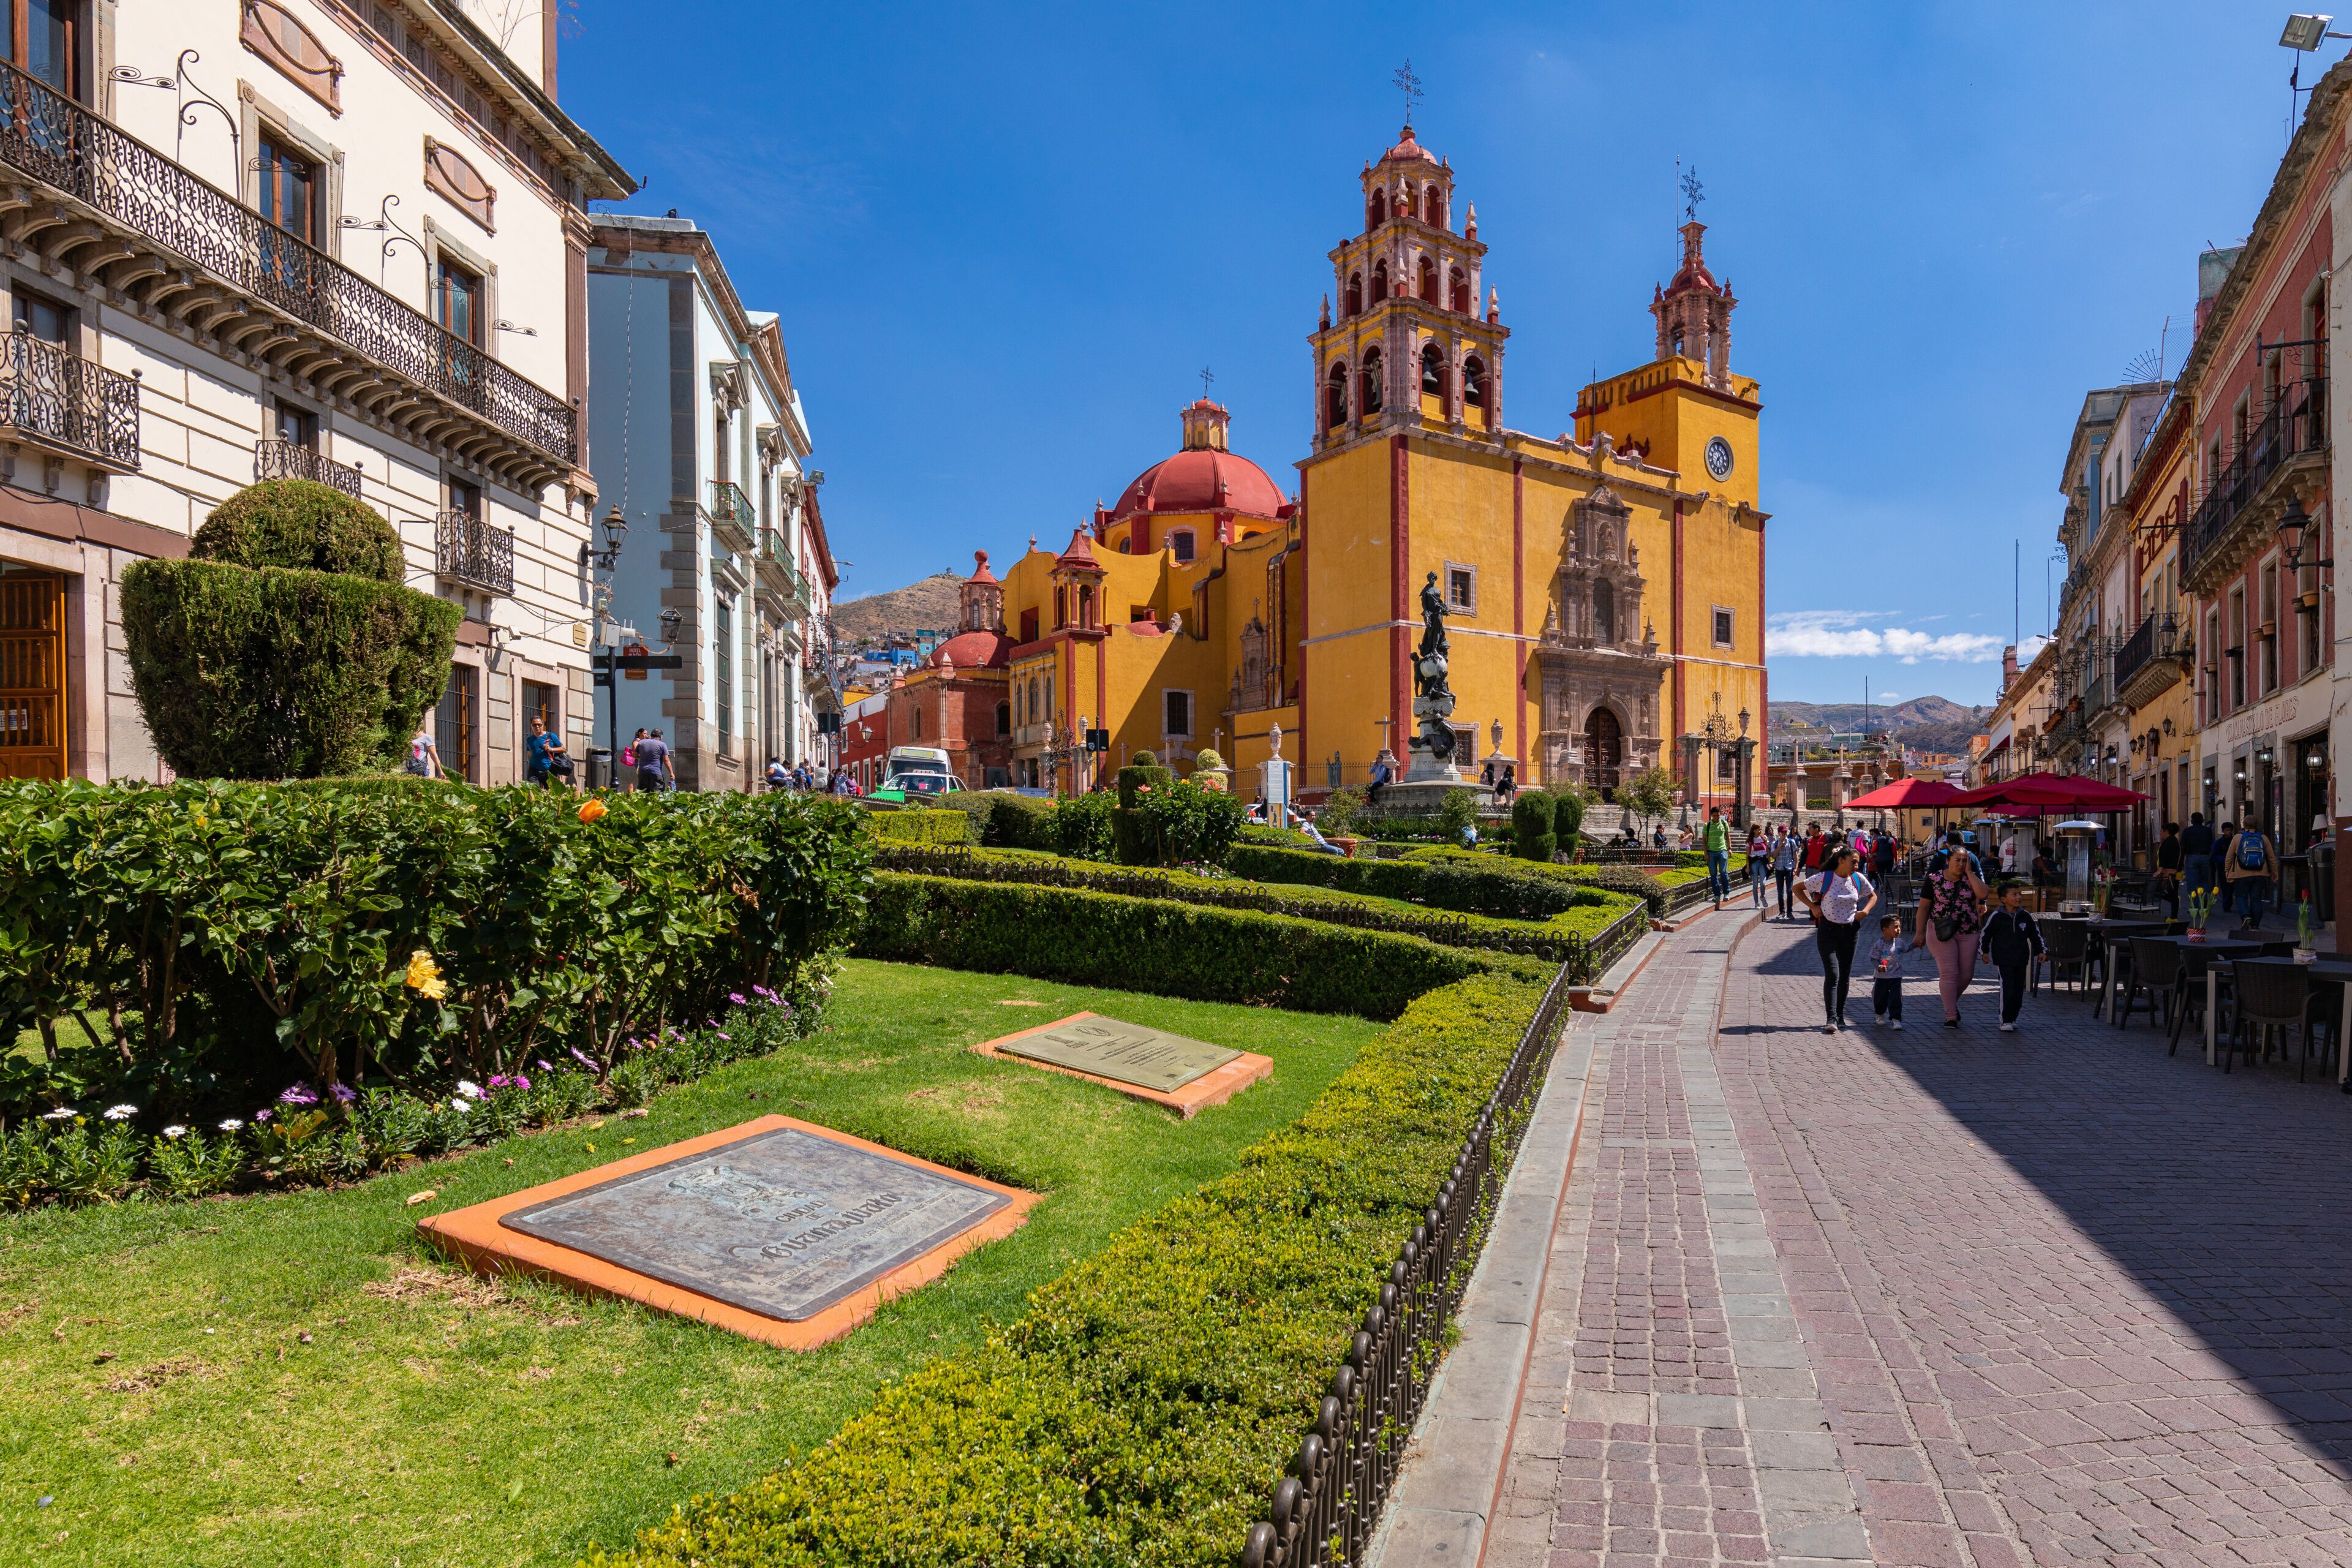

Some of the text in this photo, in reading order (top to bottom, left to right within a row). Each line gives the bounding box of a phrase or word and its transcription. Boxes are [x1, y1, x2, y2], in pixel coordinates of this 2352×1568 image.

[2265, 706, 2274, 730] DE
[775, 1200, 826, 1223] CIUDAD
[805, 1212, 824, 1221] DE
